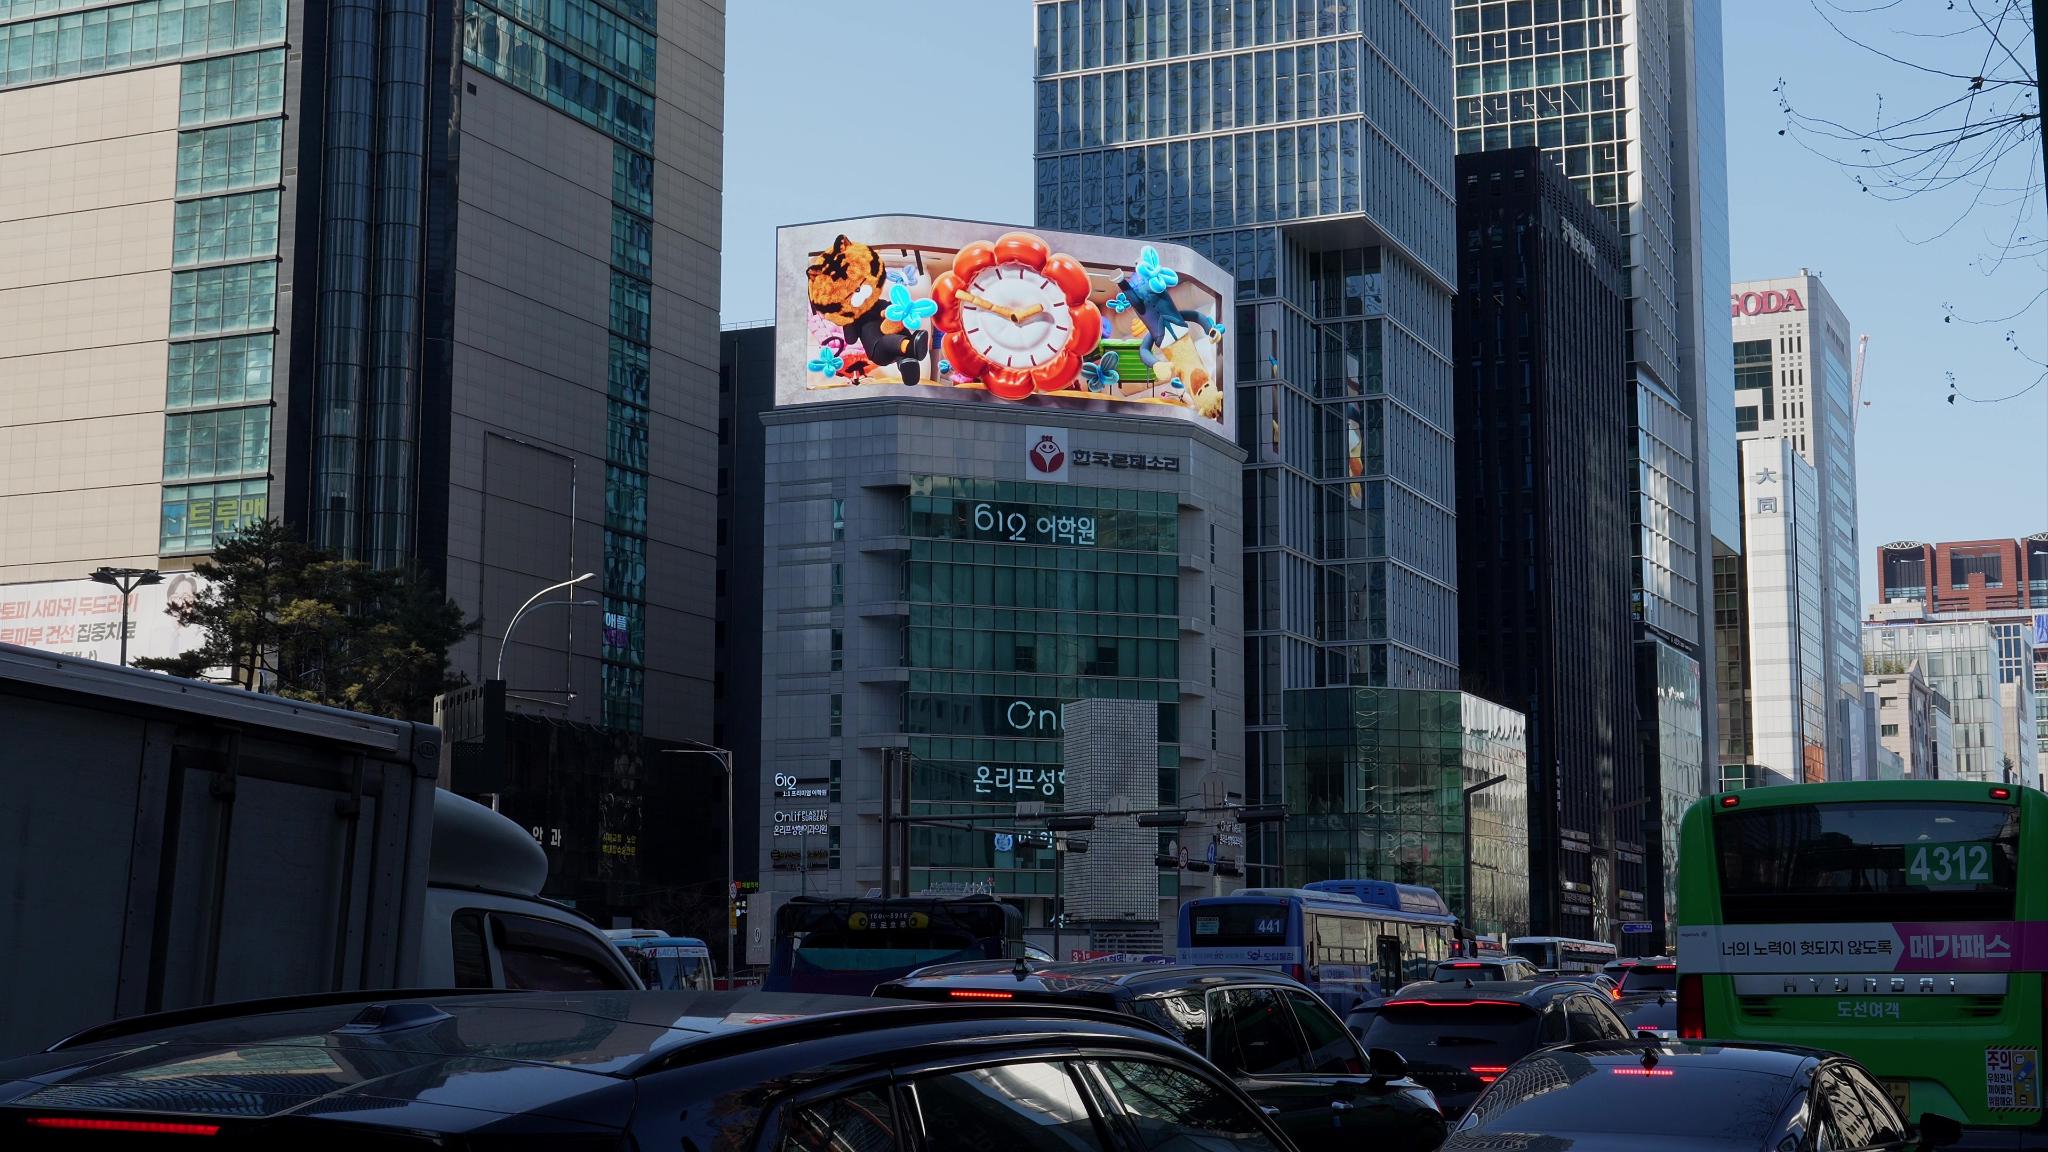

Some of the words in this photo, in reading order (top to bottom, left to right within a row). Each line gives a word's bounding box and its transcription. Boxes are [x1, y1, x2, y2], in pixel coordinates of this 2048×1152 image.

[1755, 467, 1778, 514] 大同
[974, 503, 1027, 541] 612
[1036, 514, 1095, 545] 어학원
[0, 600, 31, 619] 토피
[32, 597, 76, 618] 사마귀
[46, 624, 76, 644] 건선
[774, 772, 797, 790] 612
[774, 810, 802, 823] Onlif
[1909, 845, 1989, 881] 4312
[1257, 919, 1281, 934] 441
[1722, 941, 1750, 957] 너의
[1753, 940, 1796, 956] 노력이
[1800, 940, 1844, 956] 헛되지
[1847, 939, 1893, 955] 않도록
[1909, 934, 2012, 959] 메가패스
[1783, 976, 1957, 993] HYUNDAI
[1837, 1001, 1901, 1019] 도선여객
[1987, 1051, 2012, 1071] 주의
